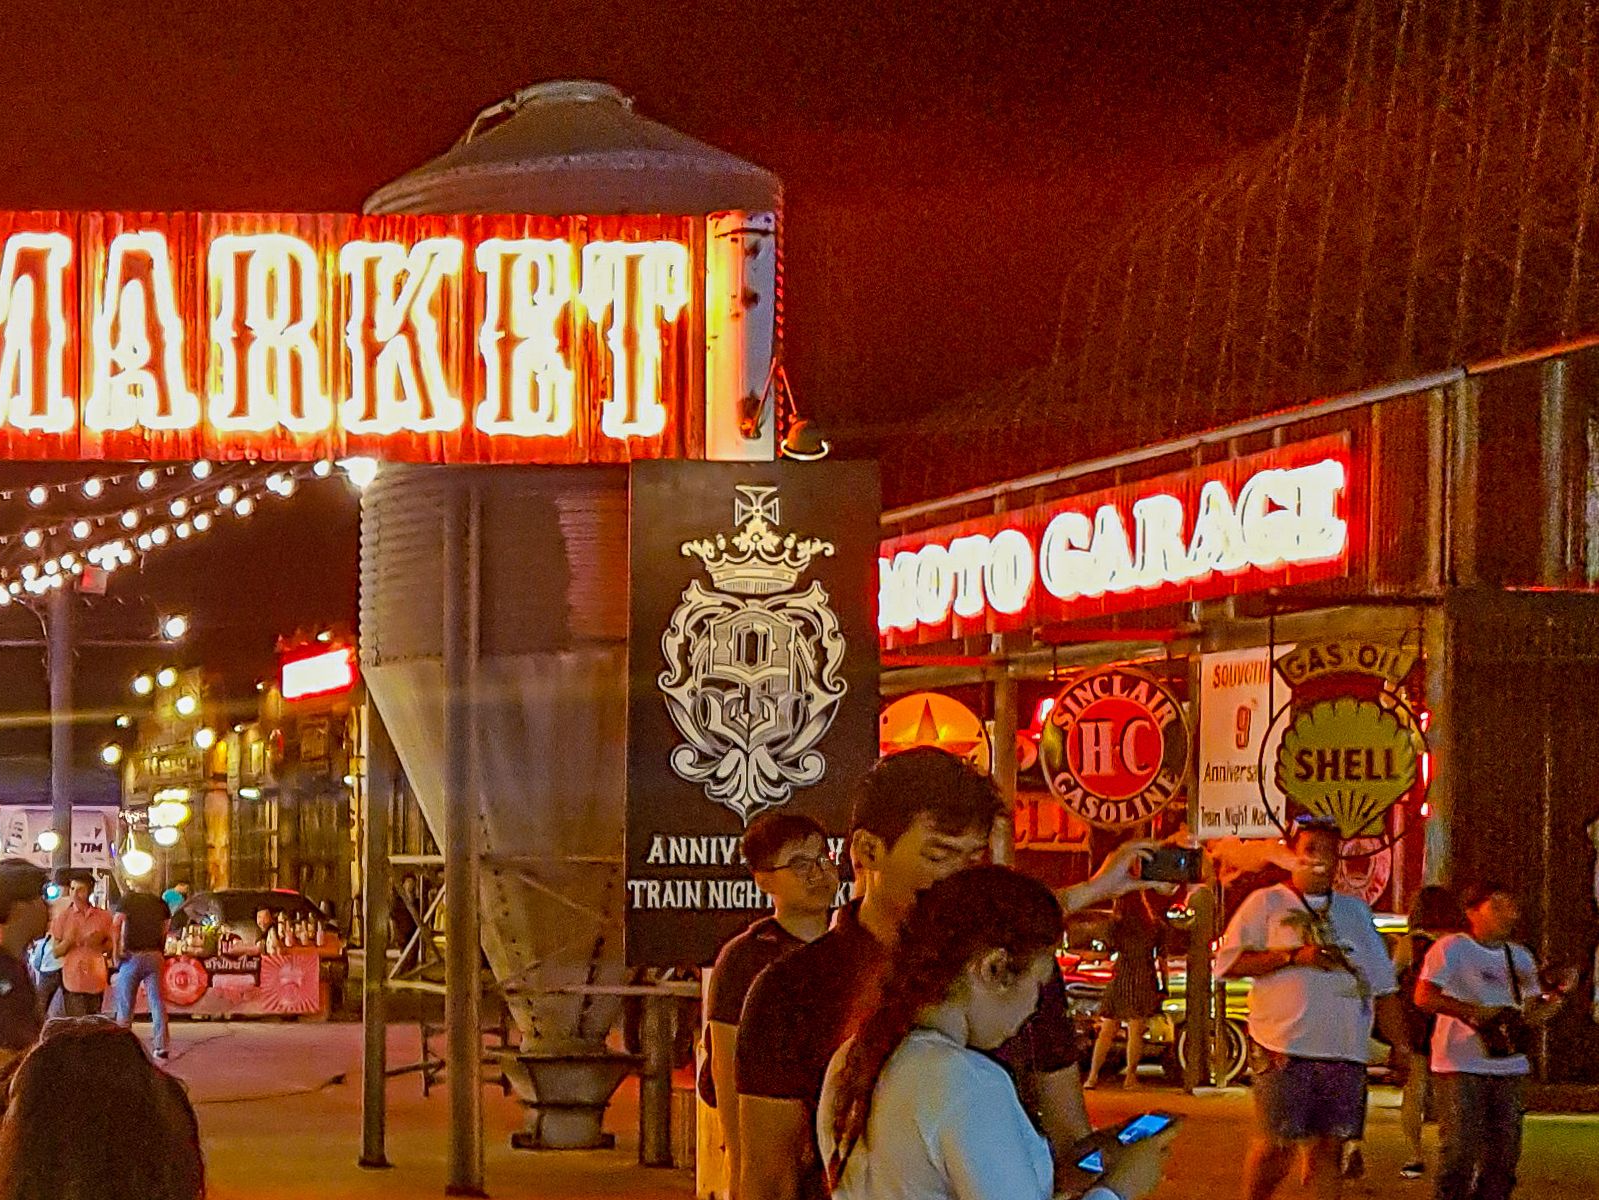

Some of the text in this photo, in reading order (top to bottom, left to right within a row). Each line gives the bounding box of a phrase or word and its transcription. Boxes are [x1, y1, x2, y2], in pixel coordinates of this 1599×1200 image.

[1040, 459, 1346, 600] GARAGE
[1052, 674, 1178, 731] SINCLAIR
[1295, 747, 1401, 782] SHELL
[1053, 770, 1179, 823] GASOLINE
[627, 880, 701, 909] TRAIN
